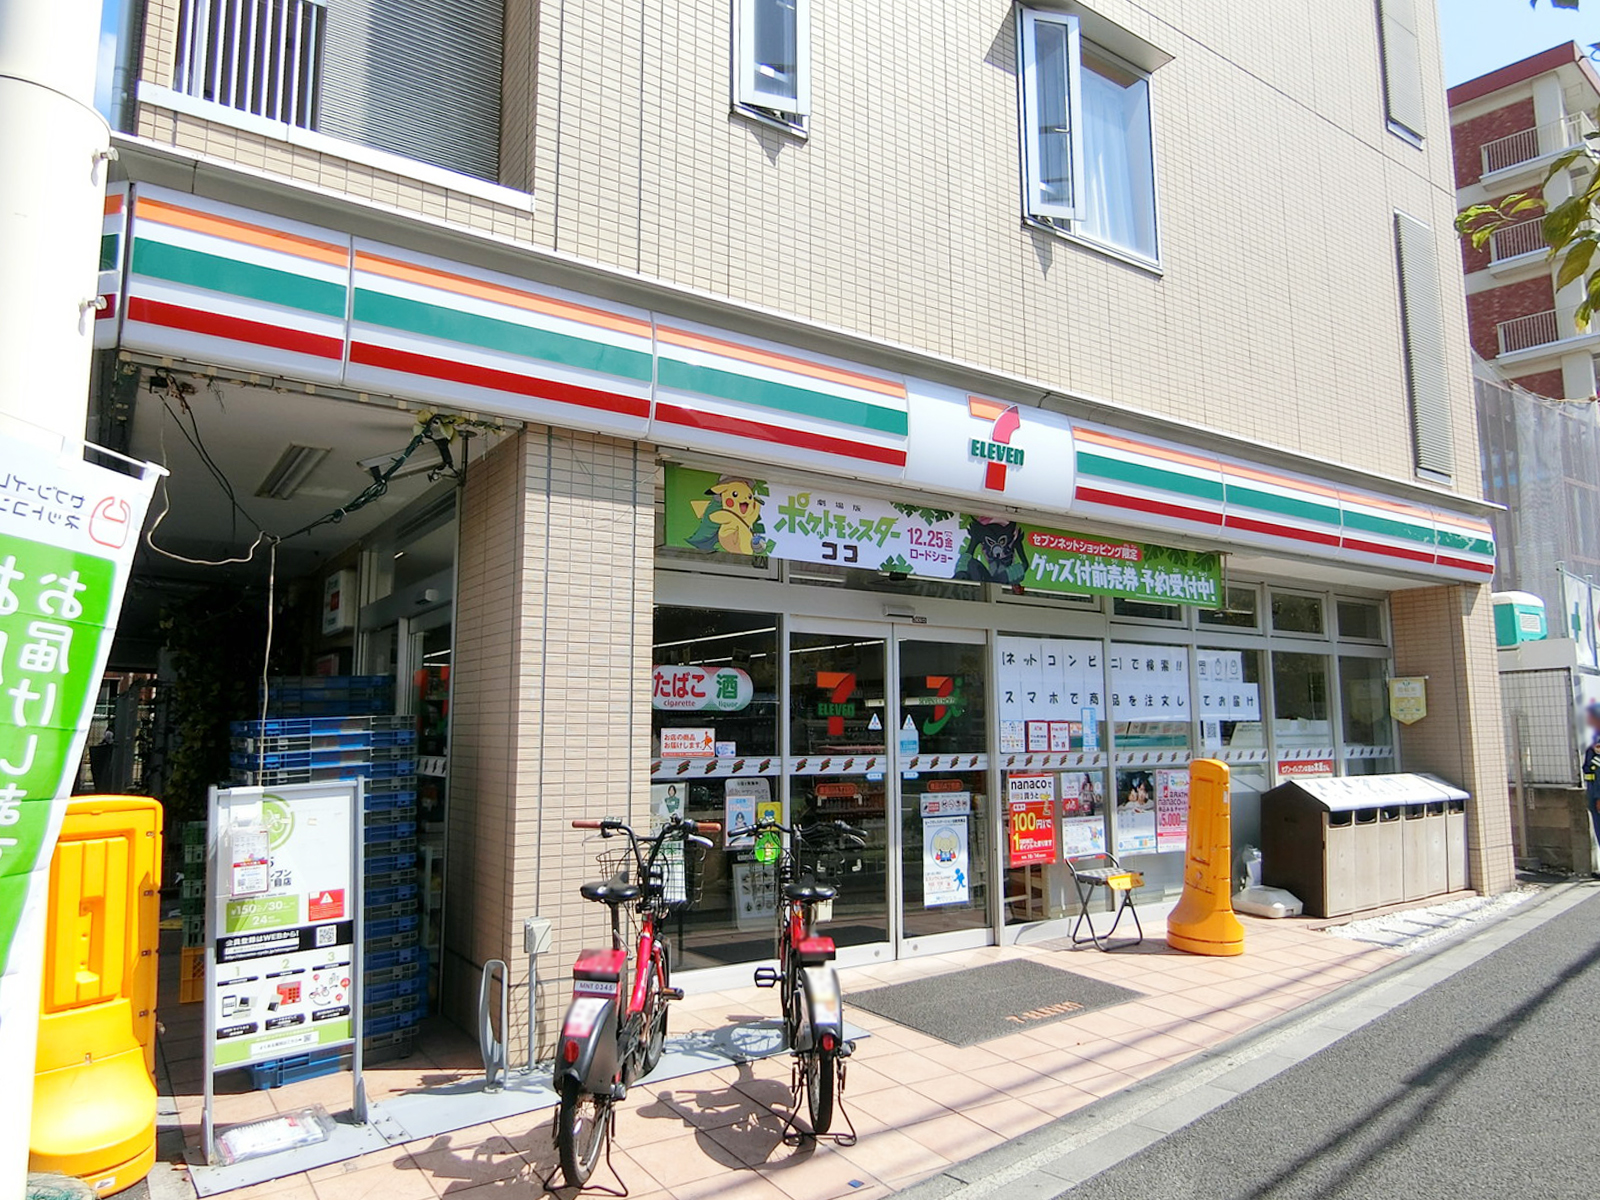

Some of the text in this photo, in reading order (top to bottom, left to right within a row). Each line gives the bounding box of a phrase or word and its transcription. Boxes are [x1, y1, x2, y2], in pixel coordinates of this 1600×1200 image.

[971, 438, 1025, 466] ELEVEN
[774, 492, 902, 548] ポケットモンスター
[821, 541, 858, 563] ココ
[906, 527, 944, 549] 12.25
[1032, 533, 1139, 561] セブンネットショッピング限定
[909, 548, 954, 564] ロードショー
[1030, 552, 1140, 592] グッズ付前売券
[653, 671, 738, 699] たばこ 酒
[663, 699, 738, 709] cigarette liquor
